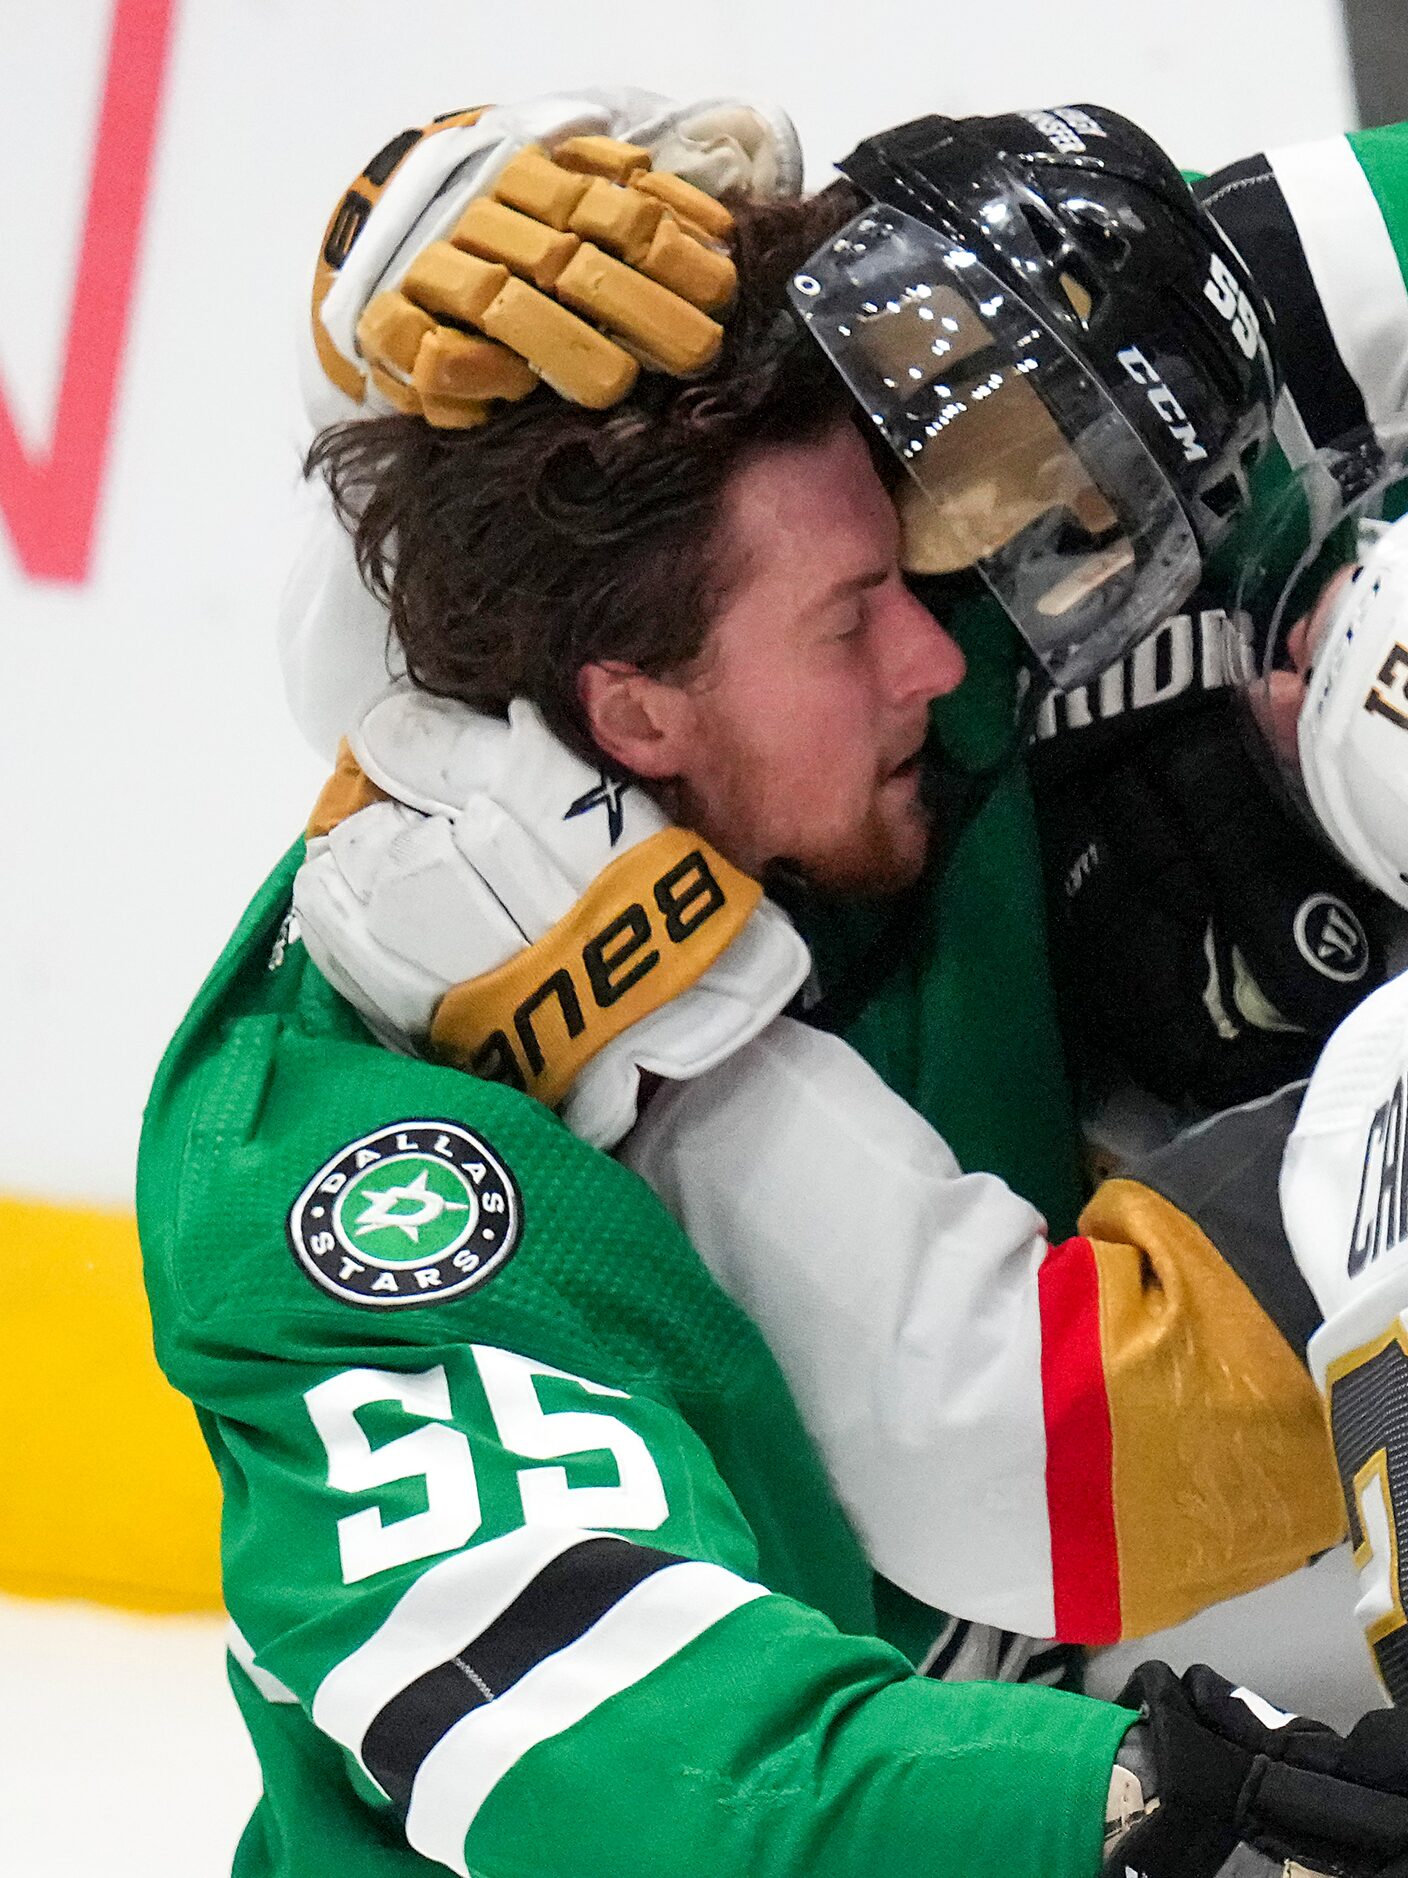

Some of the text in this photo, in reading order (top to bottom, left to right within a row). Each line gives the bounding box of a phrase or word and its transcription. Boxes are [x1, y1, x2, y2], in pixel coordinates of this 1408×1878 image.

[1203, 252, 1260, 360] 55
[1116, 345, 1208, 462] CCM
[321, 1131, 506, 1214] DALLAS
[309, 1230, 481, 1293] STARS
[303, 1342, 670, 1584] 55
